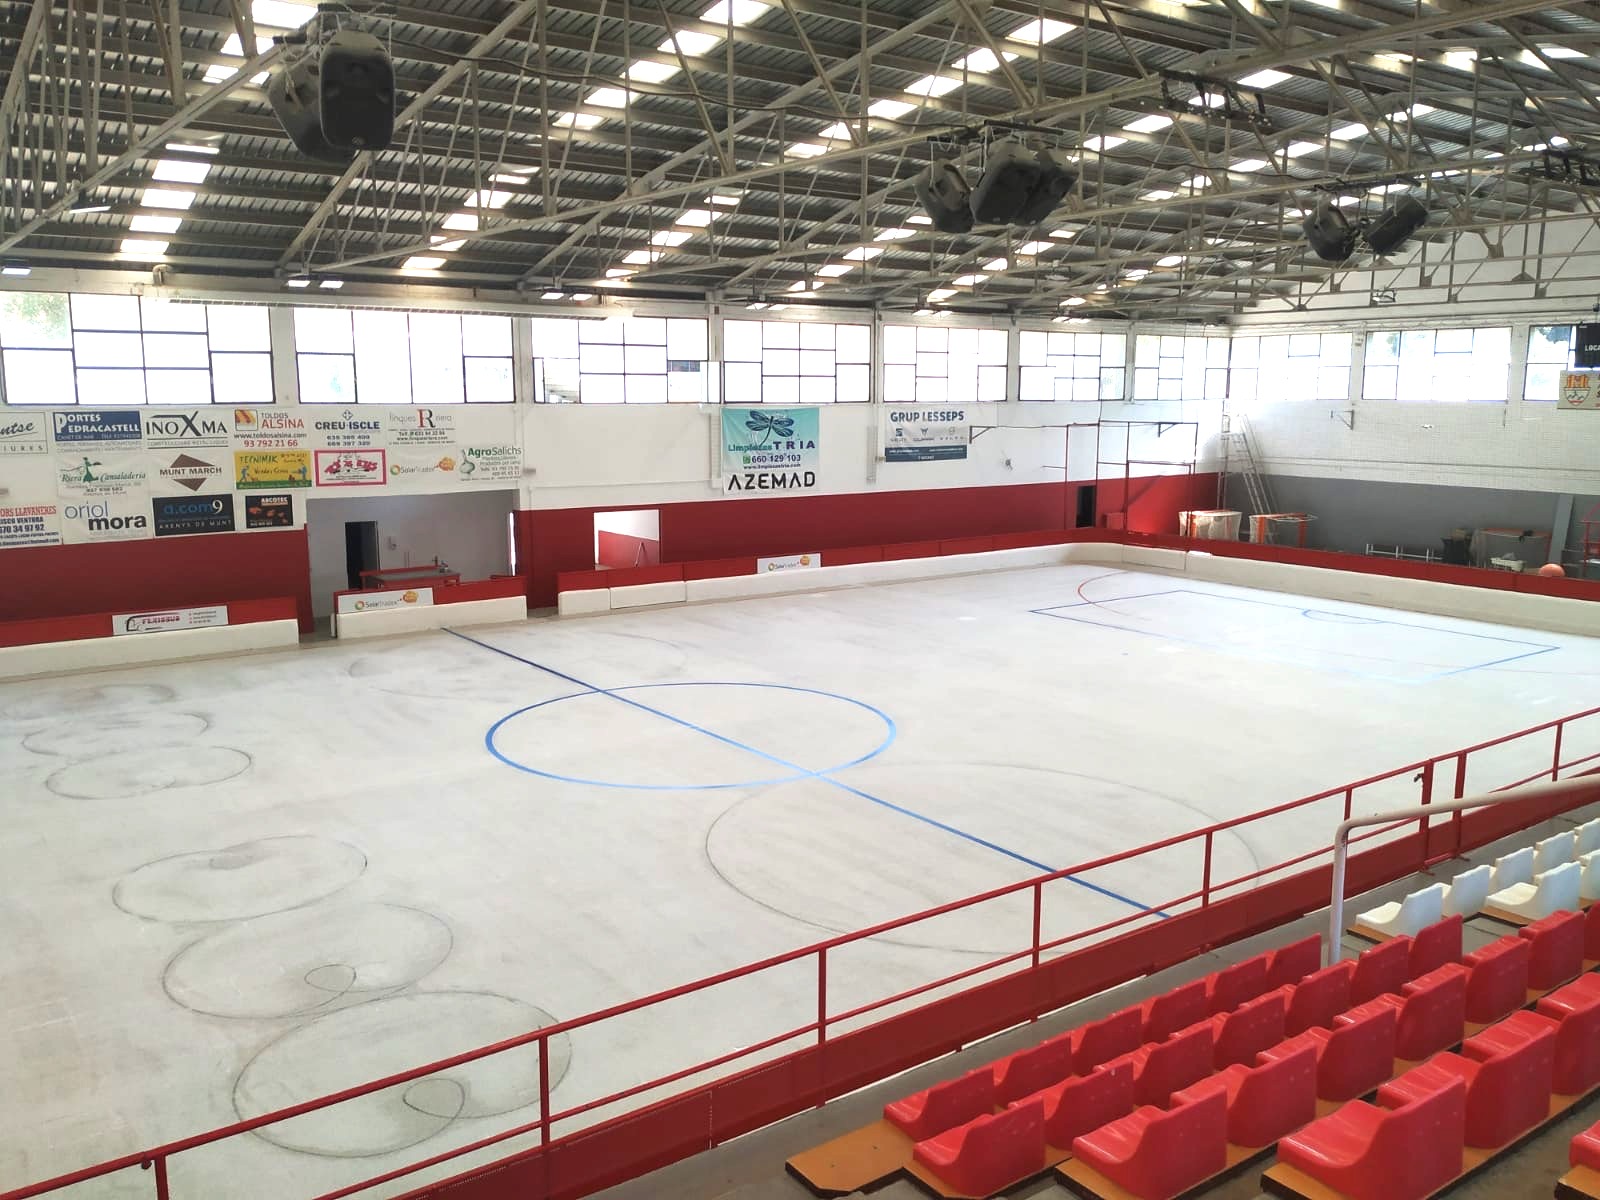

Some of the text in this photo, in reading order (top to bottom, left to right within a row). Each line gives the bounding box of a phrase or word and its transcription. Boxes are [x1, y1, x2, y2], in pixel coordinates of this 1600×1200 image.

[389, 412, 417, 424] finques
[890, 411, 965, 423] GRUP LESSEPS
[146, 410, 228, 437] INOXMA
[261, 419, 305, 429] ALSINA
[773, 440, 815, 450] TRIA
[467, 446, 522, 458] AgroSalichs
[787, 454, 801, 462] 103
[159, 467, 222, 476] MUNT MARCH
[728, 471, 815, 490] AZEMAD
[64, 500, 109, 519] oriol
[16, 516, 44, 524] VENTURA
[88, 515, 147, 531] mora
[12, 525, 23, 533] 34
[24, 524, 33, 532] 97
